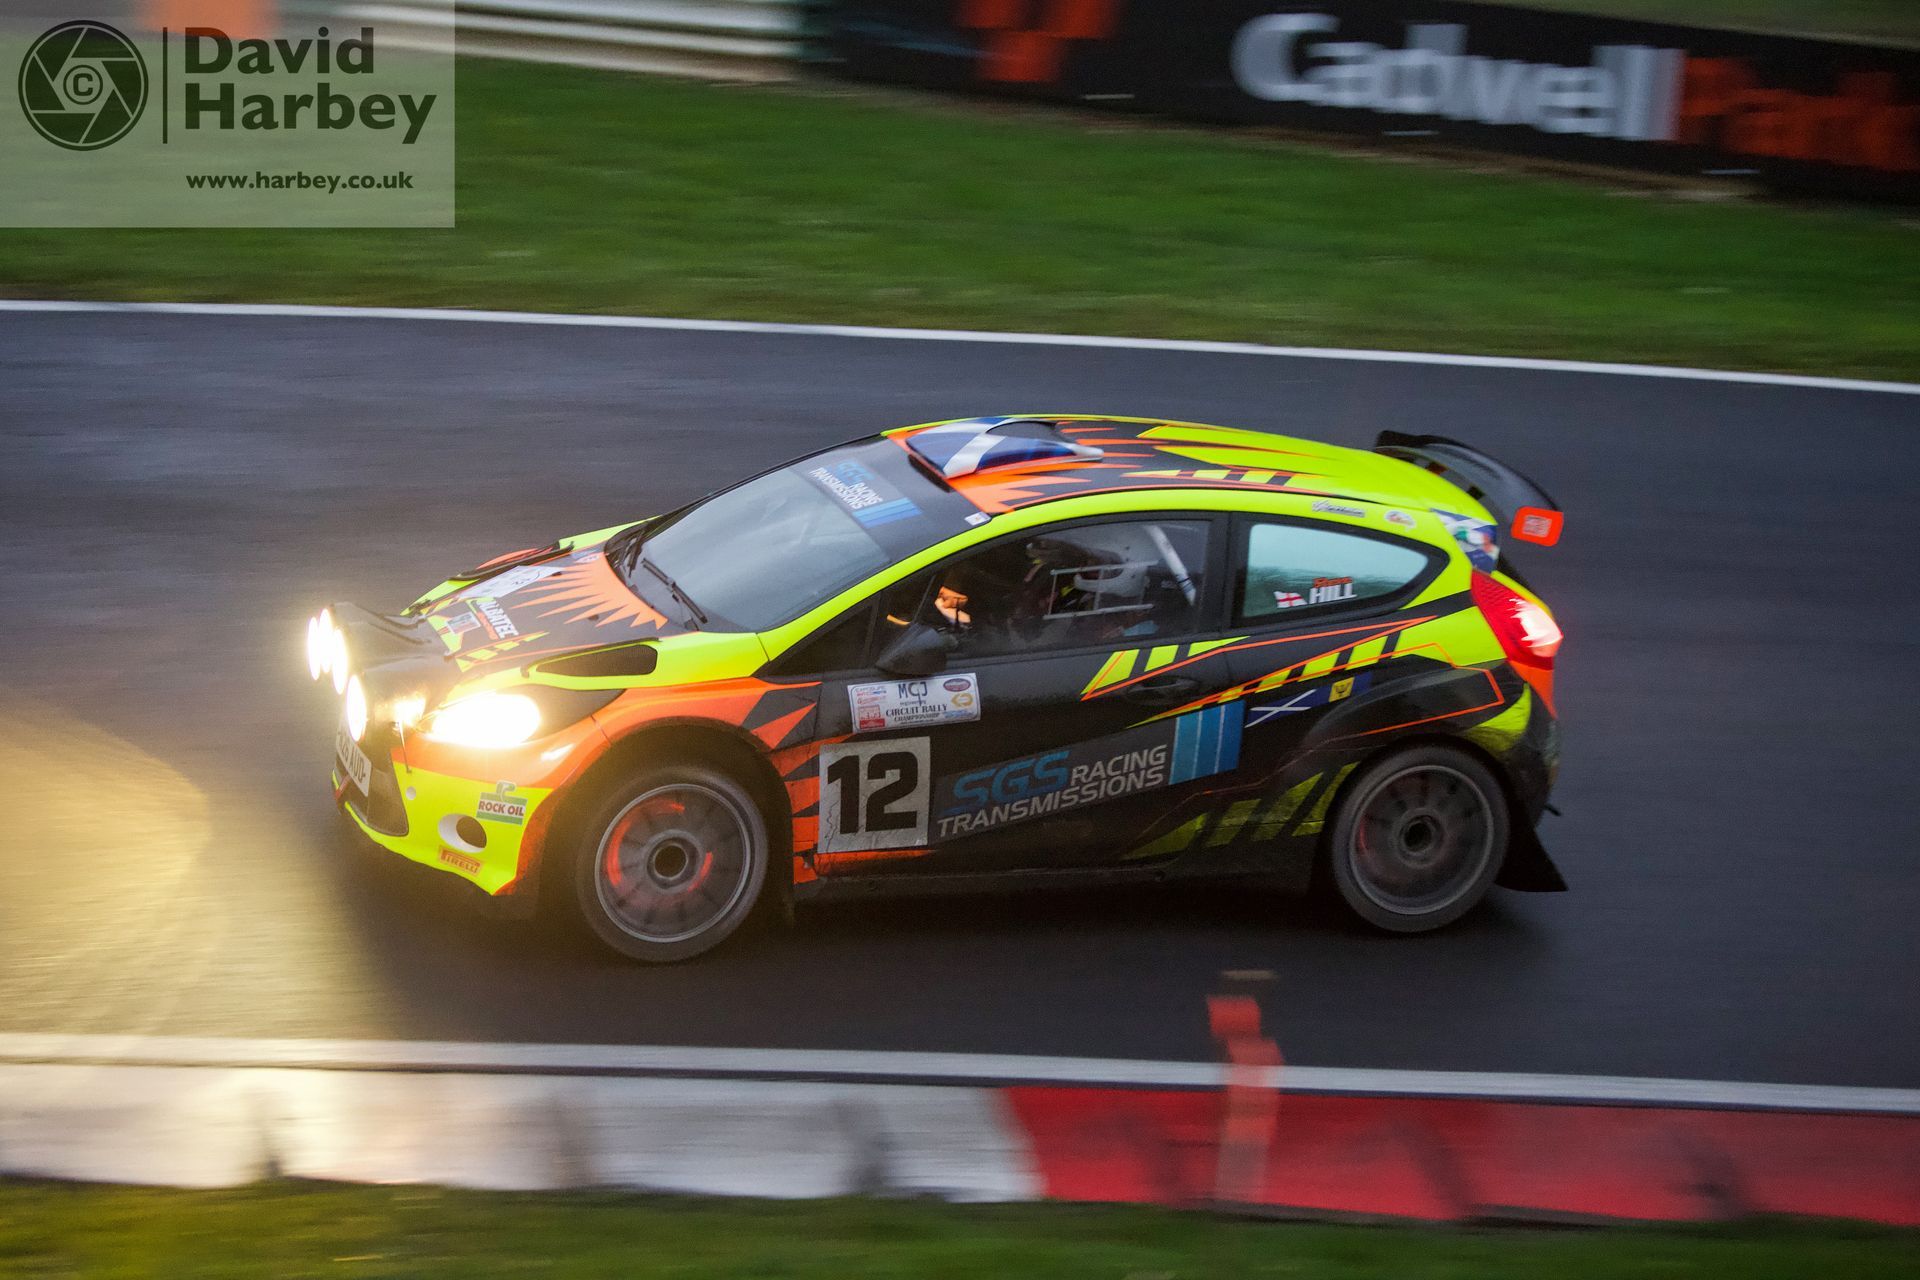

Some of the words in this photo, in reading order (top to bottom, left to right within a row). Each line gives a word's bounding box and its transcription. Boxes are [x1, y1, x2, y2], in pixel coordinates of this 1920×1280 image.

[1230, 13, 1686, 142] Cadwell
[1309, 583, 1357, 604] HILL
[886, 706, 920, 717] CIRCUIT
[922, 703, 948, 713] RALLY
[827, 751, 919, 835] 12
[937, 767, 1165, 838] TRANSMISSIONS
[951, 750, 1071, 804] SGS
[1070, 745, 1168, 786] RACING
[478, 801, 505, 813] ROCK
[507, 805, 524, 816] OIL
